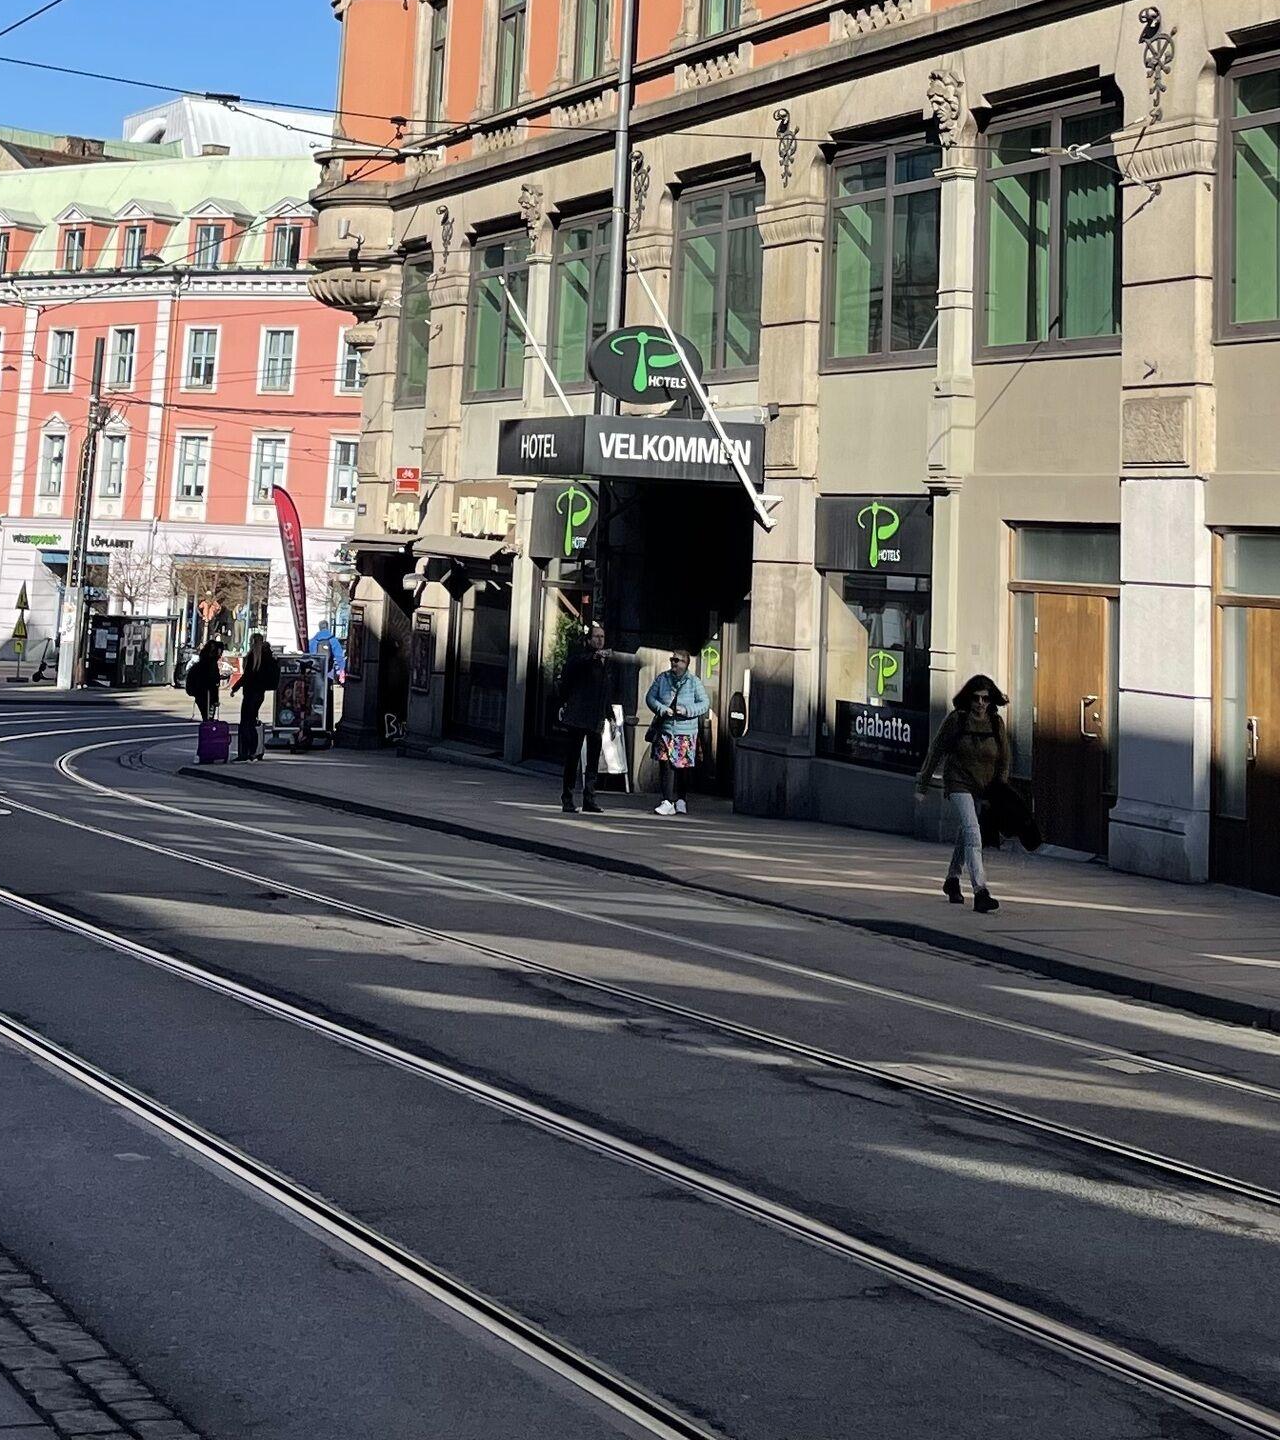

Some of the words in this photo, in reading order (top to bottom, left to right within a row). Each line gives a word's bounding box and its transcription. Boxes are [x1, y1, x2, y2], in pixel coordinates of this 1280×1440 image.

[648, 375, 687, 389] HOTELS
[520, 433, 557, 460] HOTEL
[599, 432, 752, 466] VELKOMMEN
[877, 549, 901, 562] HOTELS
[855, 710, 911, 743] ciabatta
